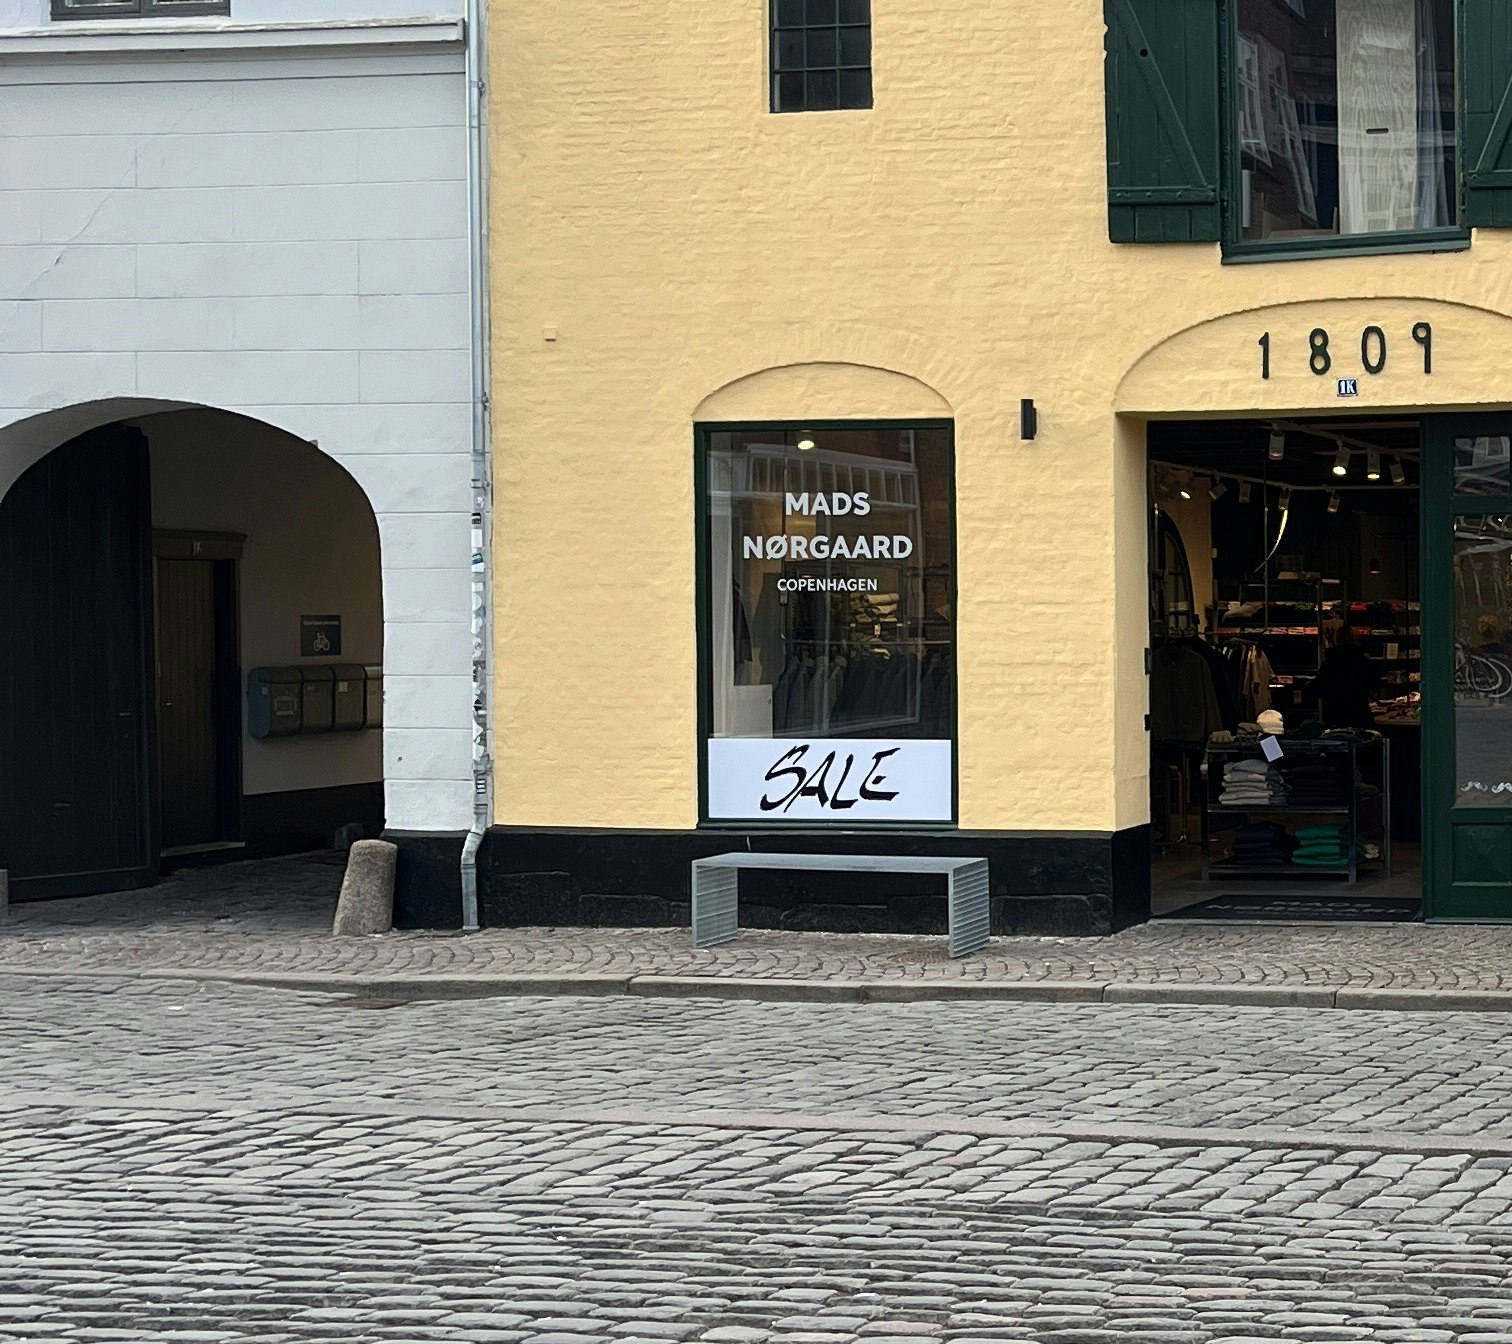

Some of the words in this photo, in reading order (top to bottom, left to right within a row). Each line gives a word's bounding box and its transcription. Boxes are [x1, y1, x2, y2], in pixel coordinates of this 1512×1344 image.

[1258, 321, 1432, 379] 1809
[784, 491, 871, 516] MADS
[743, 534, 914, 561] NØRGAARD
[777, 577, 878, 592] COPENHAGEN
[759, 743, 901, 814] SALE
